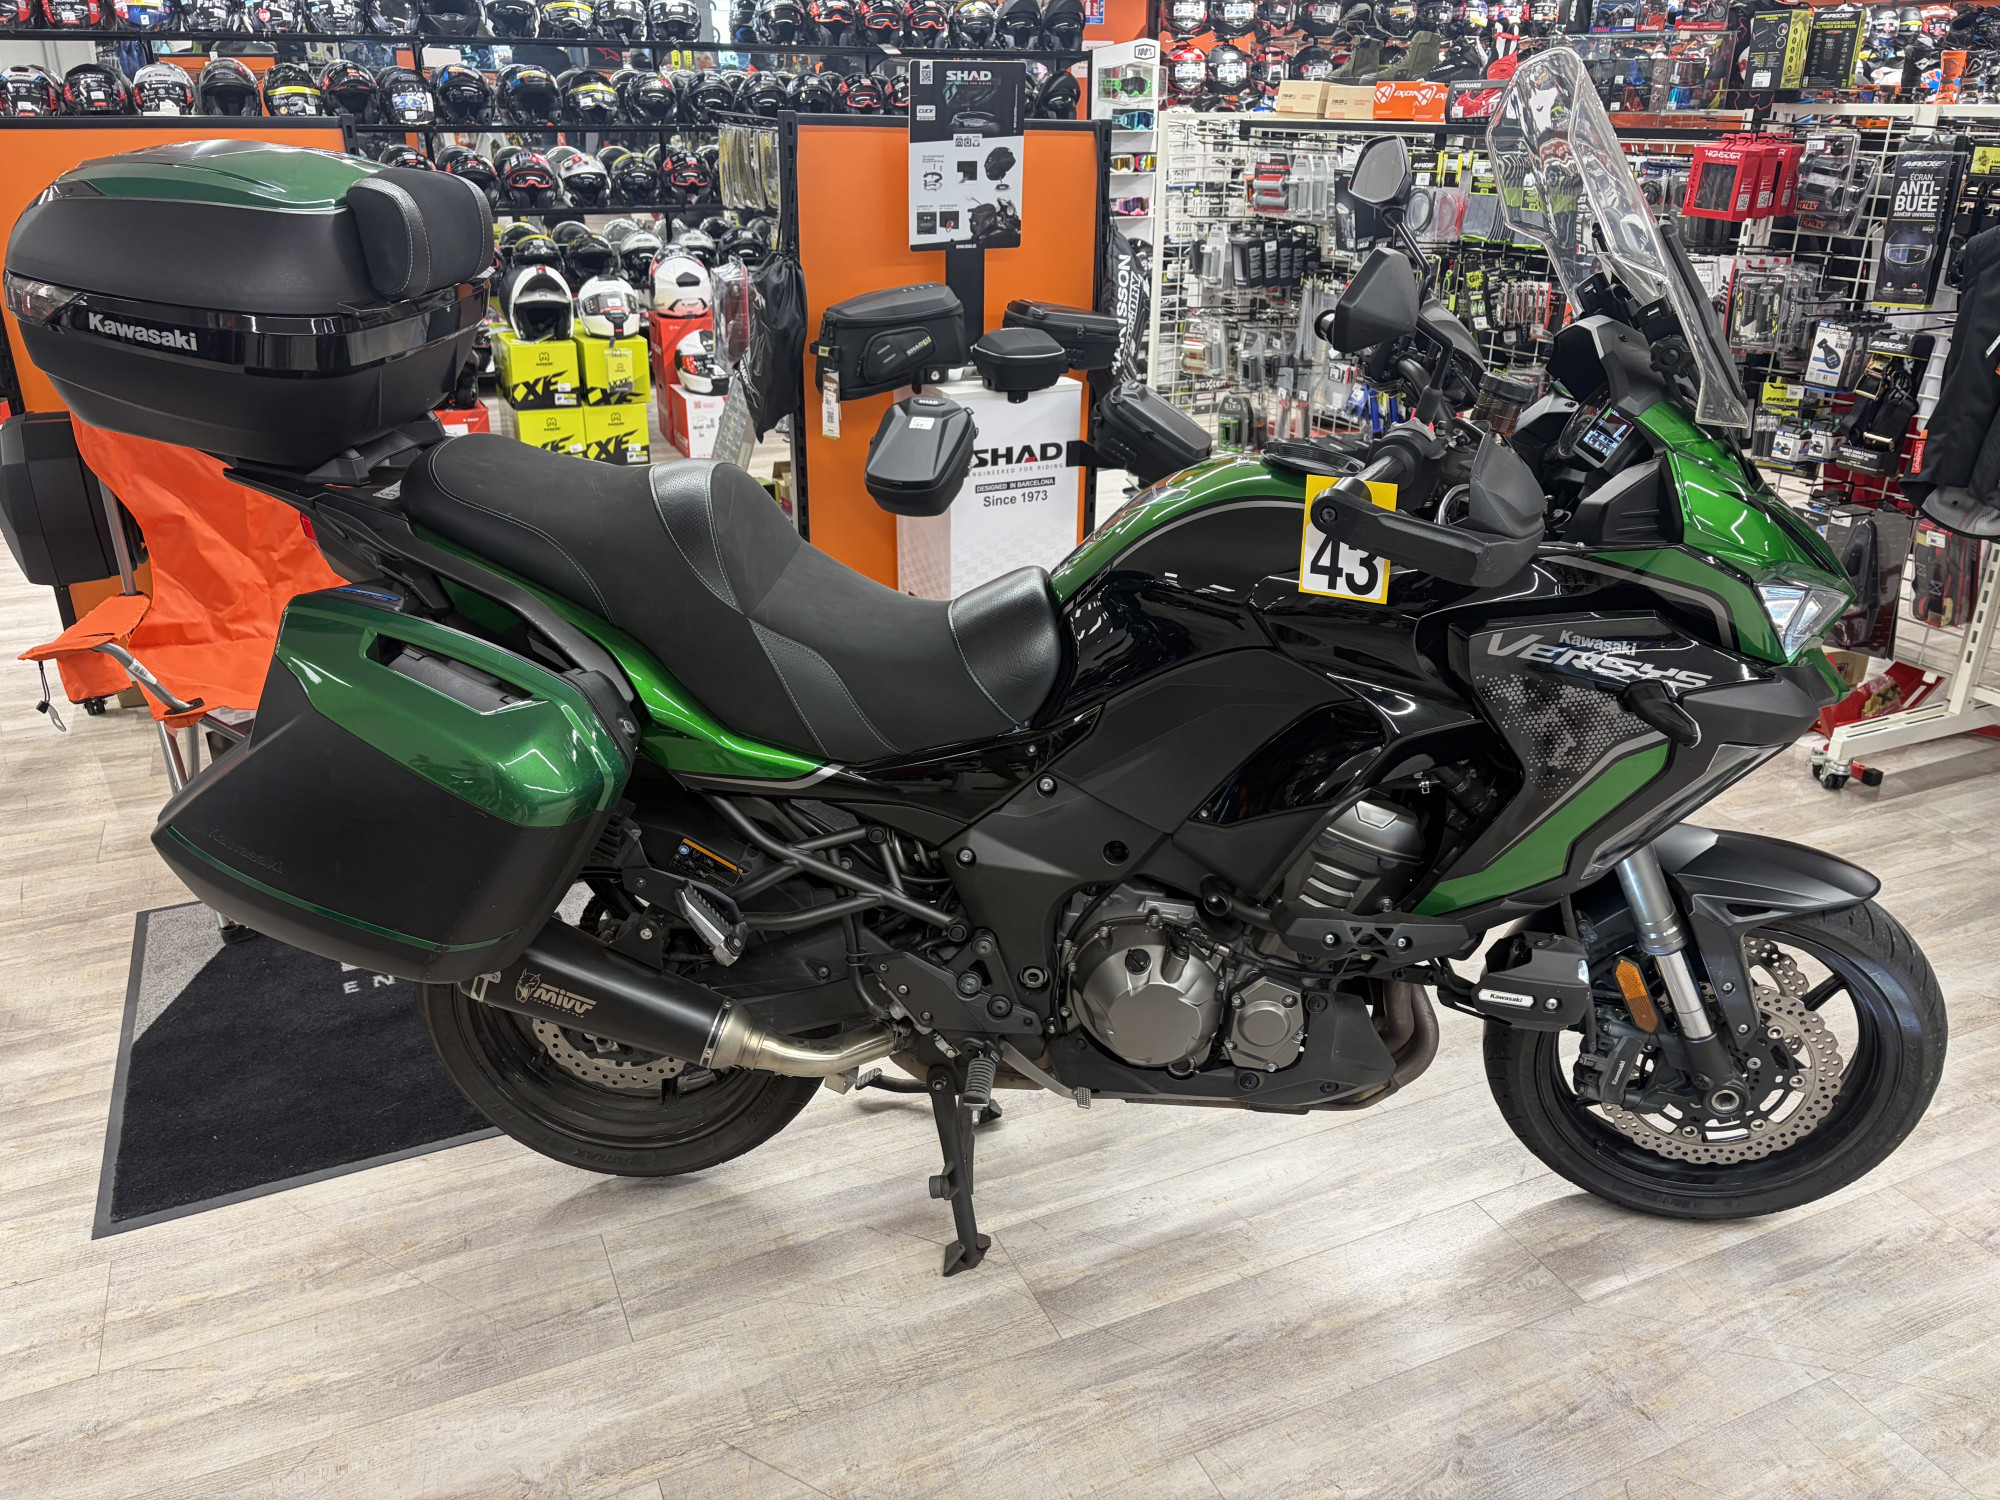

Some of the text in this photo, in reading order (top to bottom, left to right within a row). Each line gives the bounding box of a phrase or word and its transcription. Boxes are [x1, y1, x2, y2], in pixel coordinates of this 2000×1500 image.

[946, 70, 992, 81] SHAD
[1704, 150, 1742, 159] HIGHSIDER
[1897, 181, 1940, 195] ANTI-
[1797, 201, 1819, 211] RALLY
[1894, 192, 1940, 212] BUÉE
[1803, 221, 1826, 230] RALLY
[88, 312, 198, 351] Kawasaki
[1870, 340, 1909, 350] MAXXE
[972, 442, 1063, 468] SHAD
[969, 468, 1015, 477] NGINEERED
[976, 483, 1007, 492] DESIGNED
[1017, 478, 1054, 488] BARCELONA
[983, 490, 1048, 507] Since 1973
[1310, 534, 1379, 595] 43
[1559, 630, 1637, 656] Kawasaki
[1487, 632, 1713, 689] VERSYS
[208, 828, 284, 874] Kawasaki
[1490, 993, 1523, 1003] Kawasaki
[1611, 1060, 1626, 1086] Kawasaki
